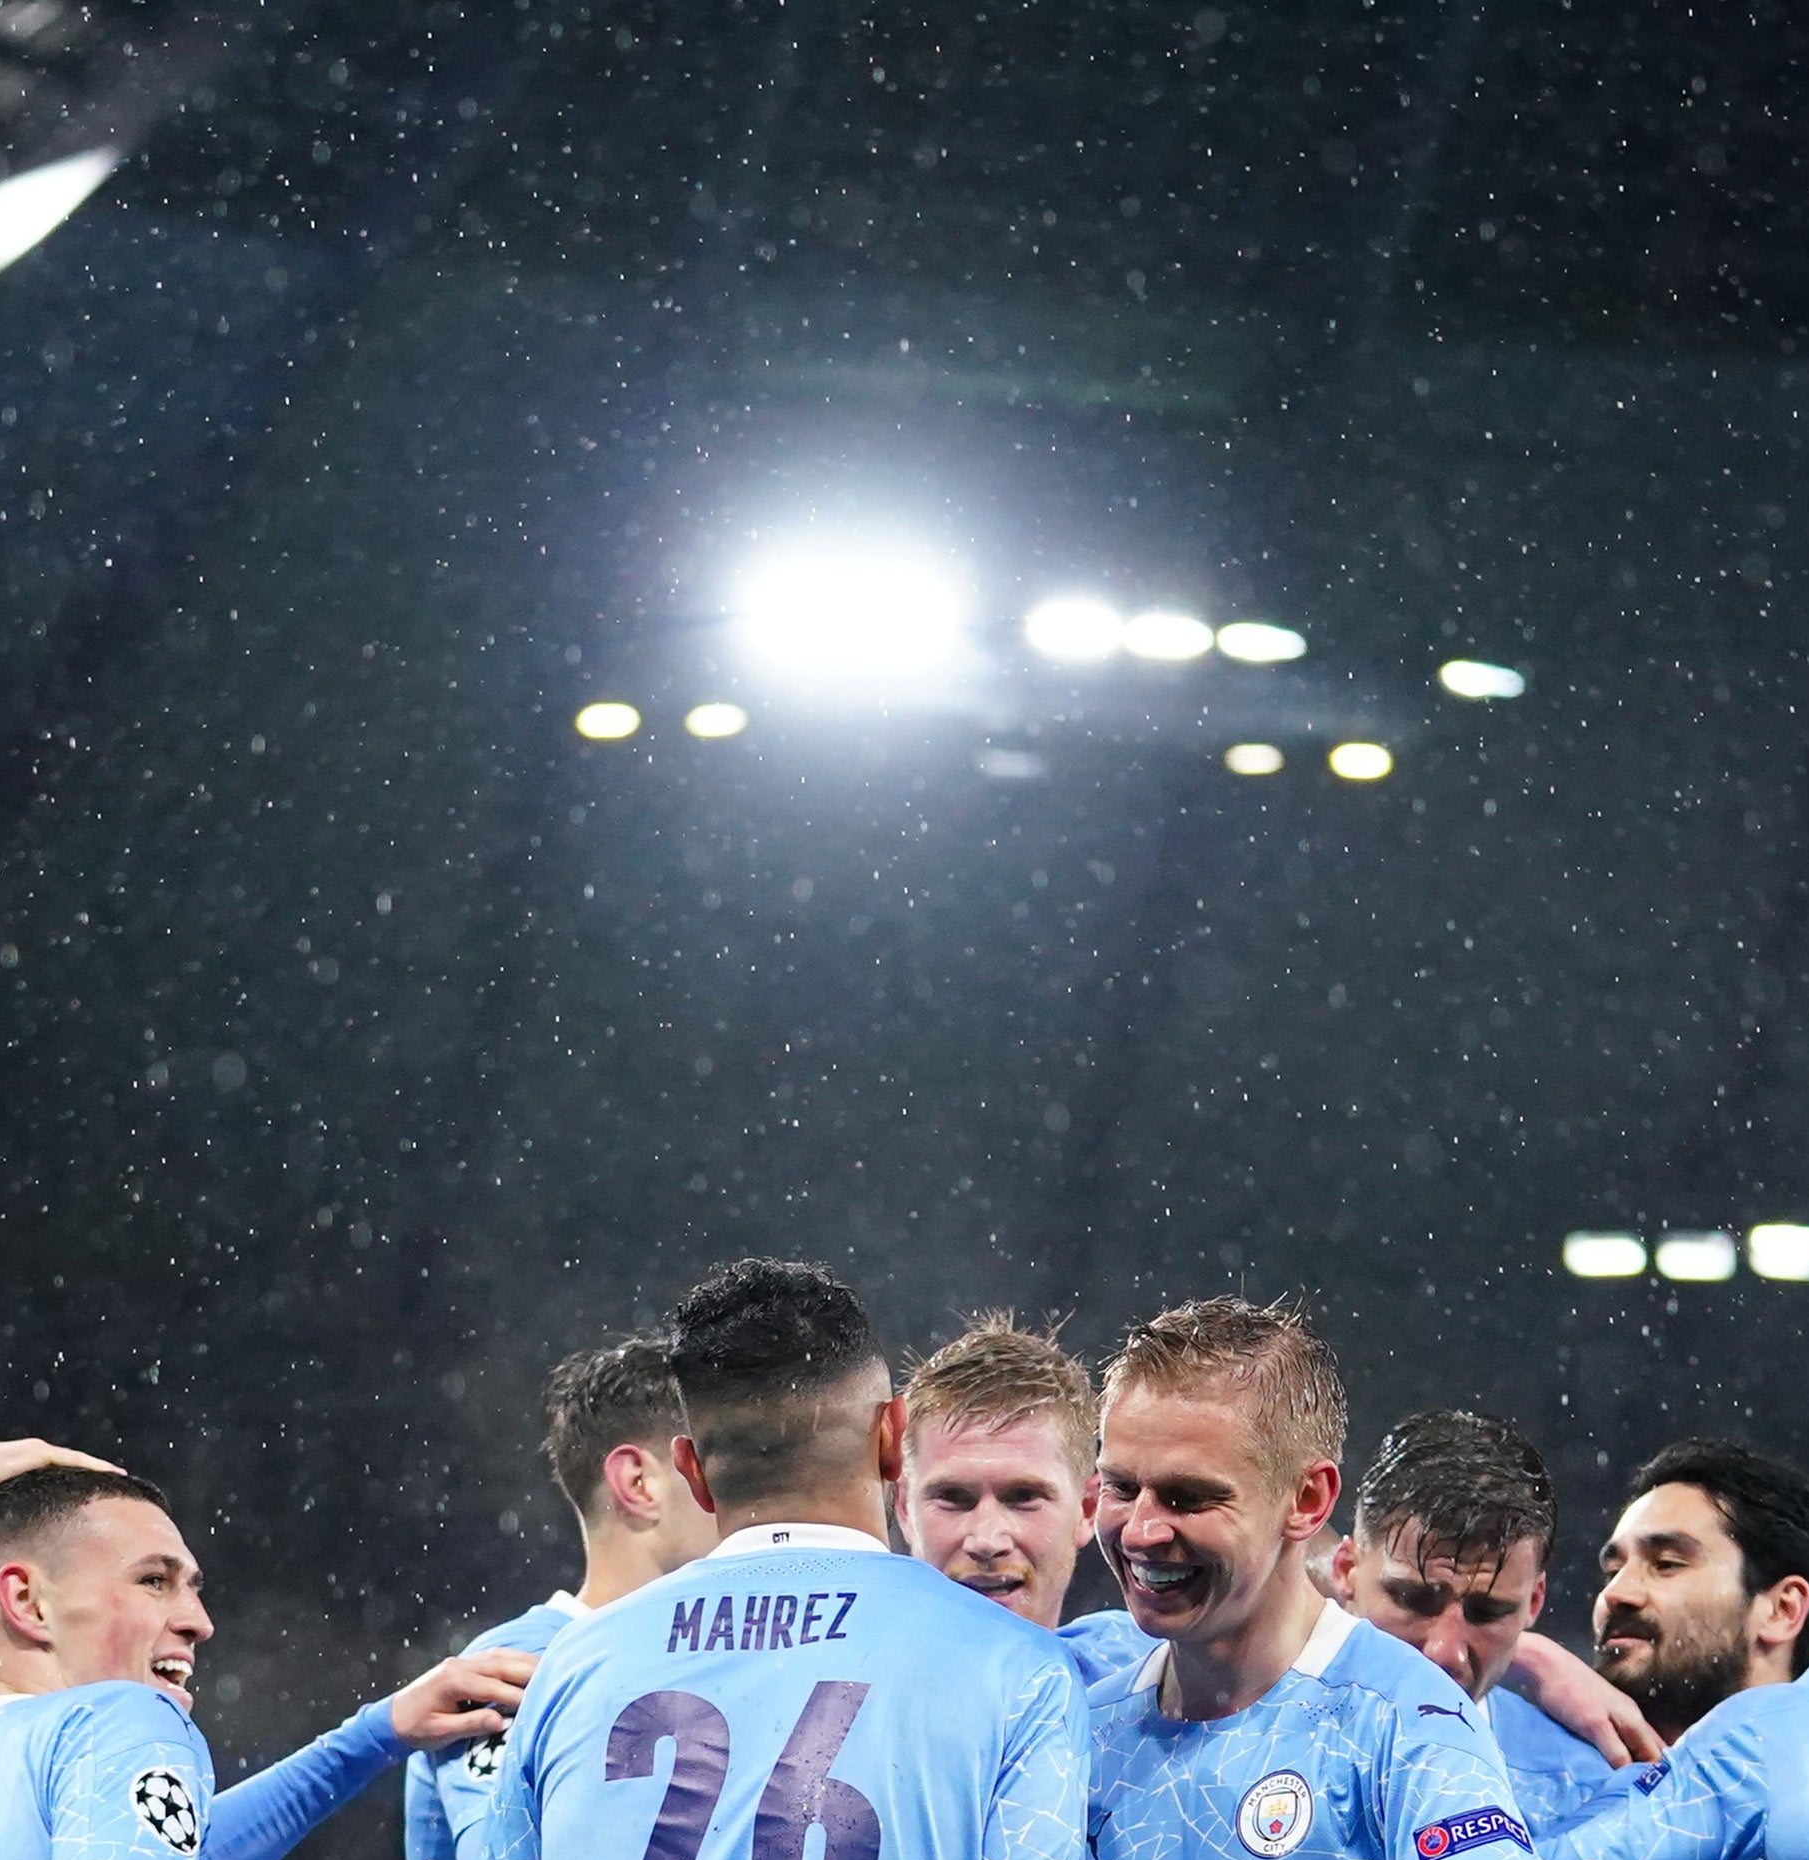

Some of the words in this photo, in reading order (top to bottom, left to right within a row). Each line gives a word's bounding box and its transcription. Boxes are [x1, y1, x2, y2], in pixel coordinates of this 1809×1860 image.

[666, 1592, 858, 1653] MAHREZ
[1248, 1776, 1308, 1807] MANCHESTER
[1451, 1814, 1528, 1843] RESPECT
[1263, 1842, 1286, 1853] CITY
